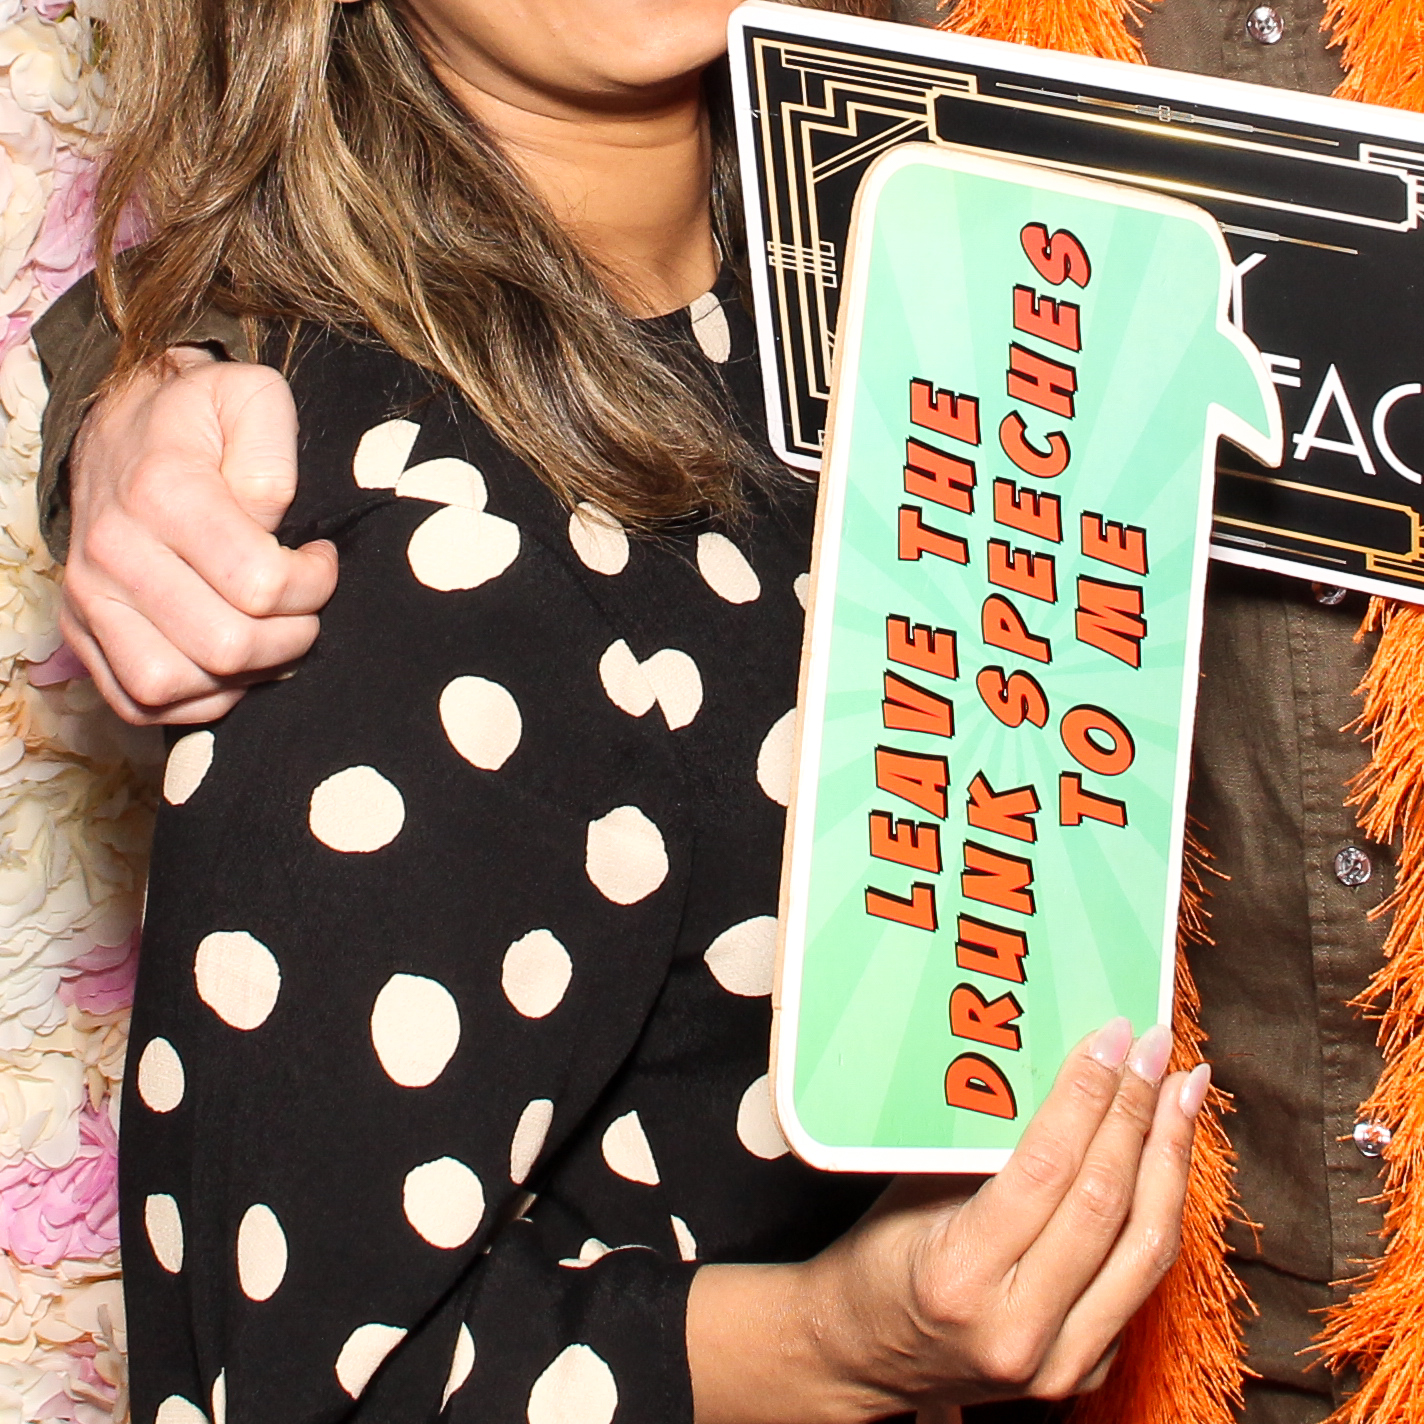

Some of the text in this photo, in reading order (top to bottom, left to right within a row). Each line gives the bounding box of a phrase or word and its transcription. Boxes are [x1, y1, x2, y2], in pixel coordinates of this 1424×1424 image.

[865, 377, 982, 933] LEAVE THE
[944, 222, 1092, 1121] DRUNK SPEECHES
[1059, 510, 1150, 829] TO ME
